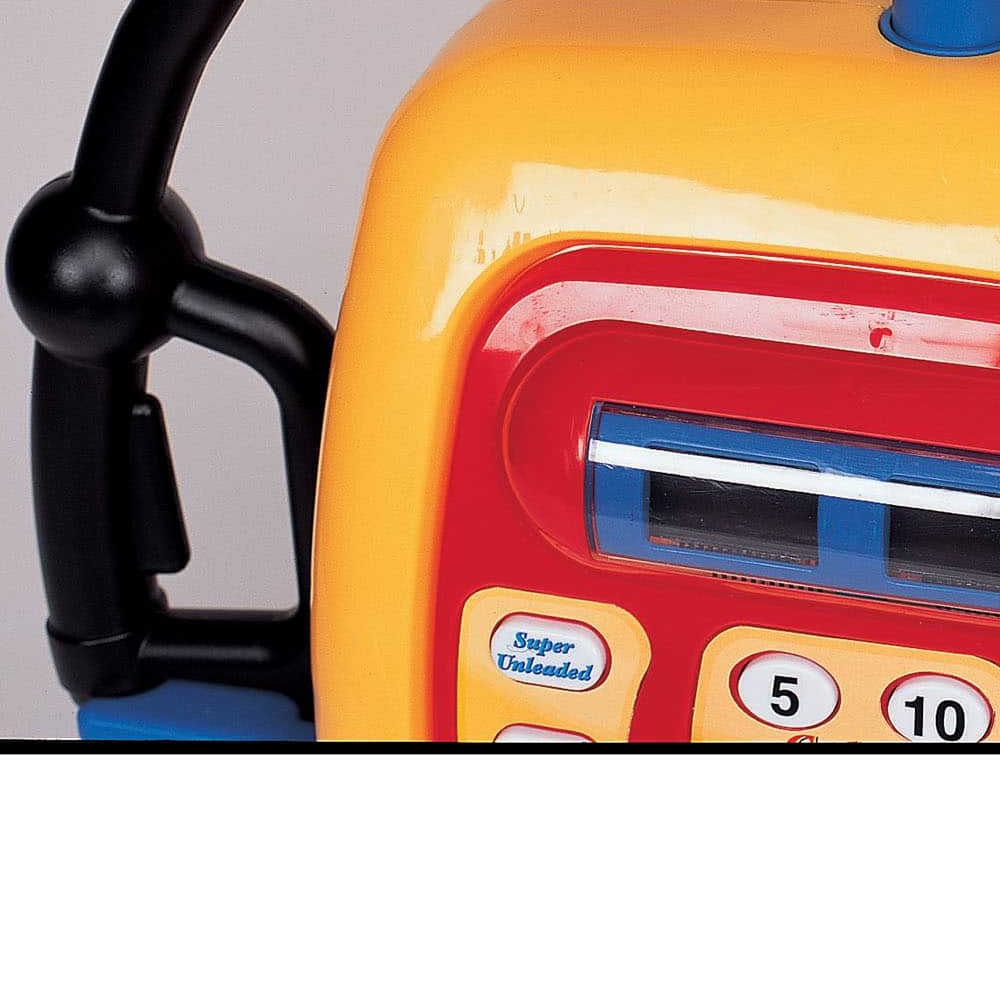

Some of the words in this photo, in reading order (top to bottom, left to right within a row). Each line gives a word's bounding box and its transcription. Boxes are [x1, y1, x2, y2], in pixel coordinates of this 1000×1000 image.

[513, 631, 575, 656] Super
[497, 653, 593, 681] Unleaded
[770, 675, 800, 717] 5
[904, 695, 966, 742] 10
